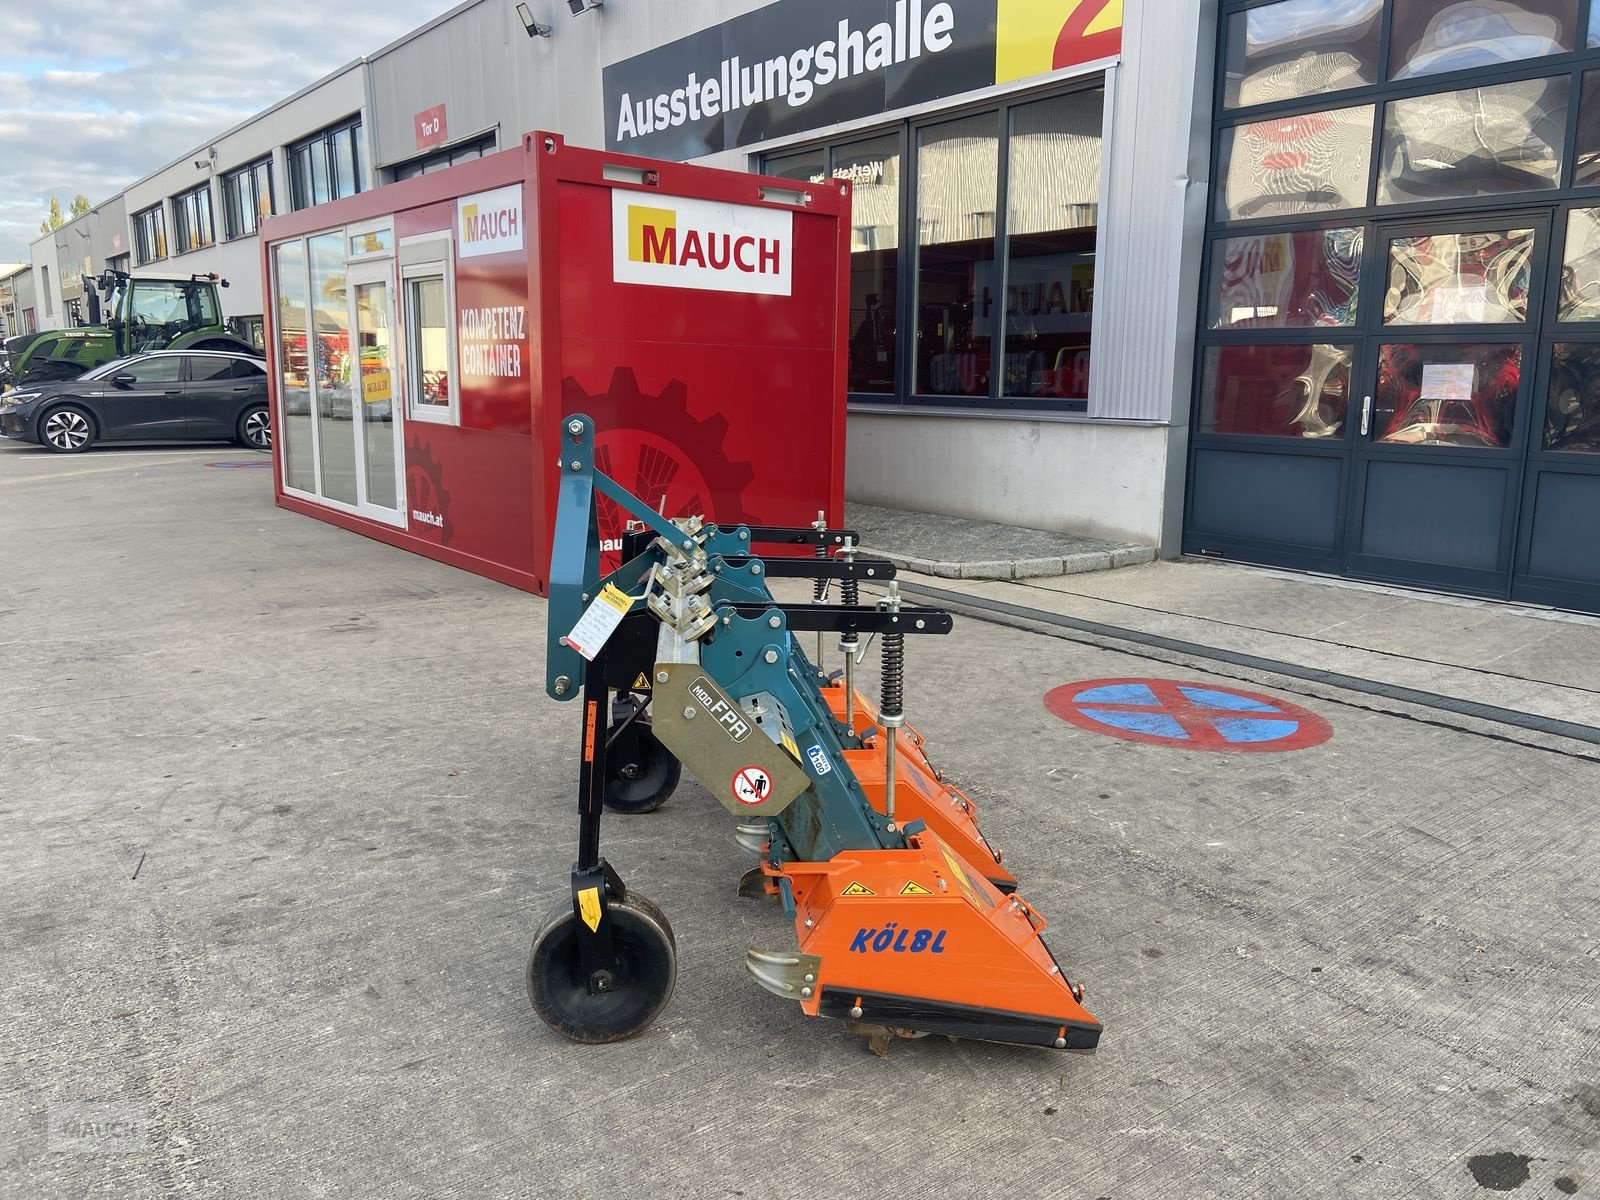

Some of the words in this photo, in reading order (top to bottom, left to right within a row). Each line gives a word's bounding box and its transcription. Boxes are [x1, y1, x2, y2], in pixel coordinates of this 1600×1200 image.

[616, 0, 954, 141] Ausstellungshalle
[421, 121, 433, 138] Tor
[433, 118, 440, 133] D
[466, 208, 518, 242] MAUCH
[642, 224, 780, 275] MAUCH
[461, 306, 525, 340] KOMPETENZ
[463, 344, 521, 377] CONTAINER
[412, 509, 443, 528] mauch.at
[692, 685, 714, 709] MOD.
[710, 699, 748, 739] FPA
[848, 922, 948, 954] KÖLBL
